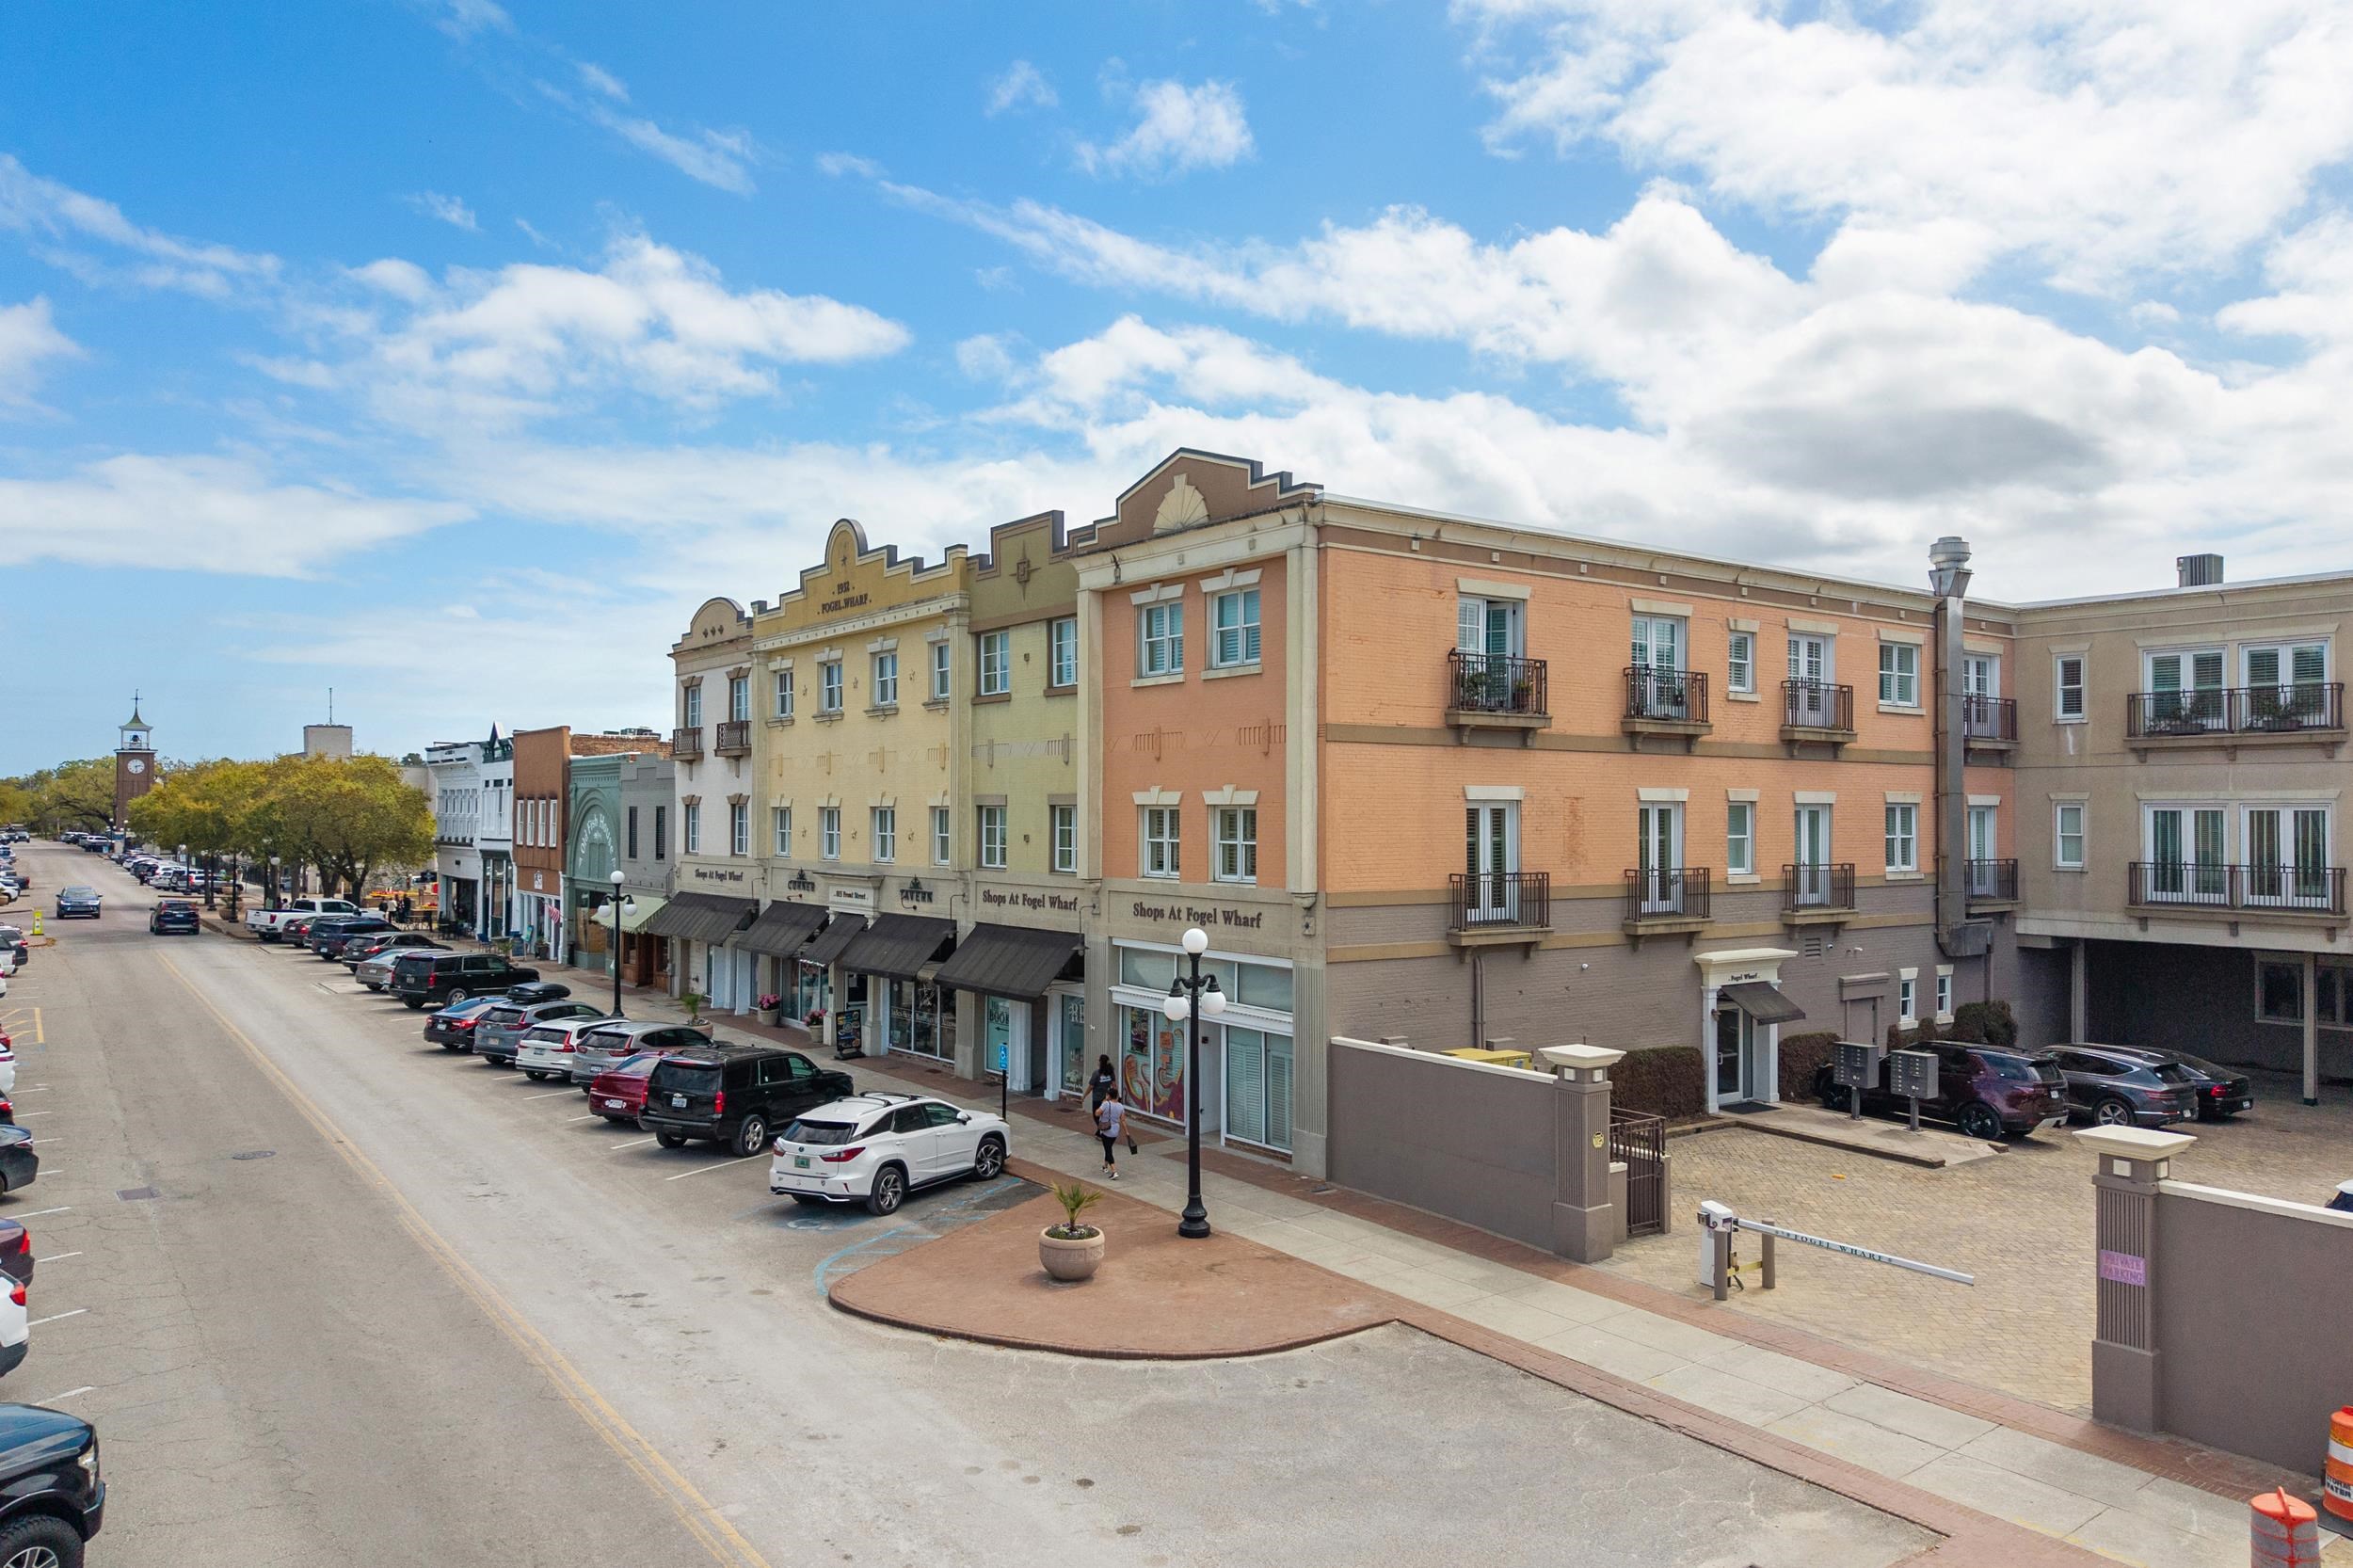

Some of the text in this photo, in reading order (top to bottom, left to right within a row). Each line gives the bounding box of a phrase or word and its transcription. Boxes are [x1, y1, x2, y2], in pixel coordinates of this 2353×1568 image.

[822, 593, 869, 614] FOGEL WHARF
[580, 813, 614, 855] Old Fish House
[695, 868, 744, 882] Shops At Fogel Wharf
[787, 880, 816, 892] CORNER
[899, 888, 934, 904] TAVERN
[982, 889, 1079, 911] Shops At Fogel Wharf
[1132, 902, 1263, 929] Shops At Fogel Wharf
[1839, 1244, 1883, 1261] WHARF
[2103, 1254, 2143, 1271] PRIVATE
[2103, 1265, 2143, 1284] PARKING
